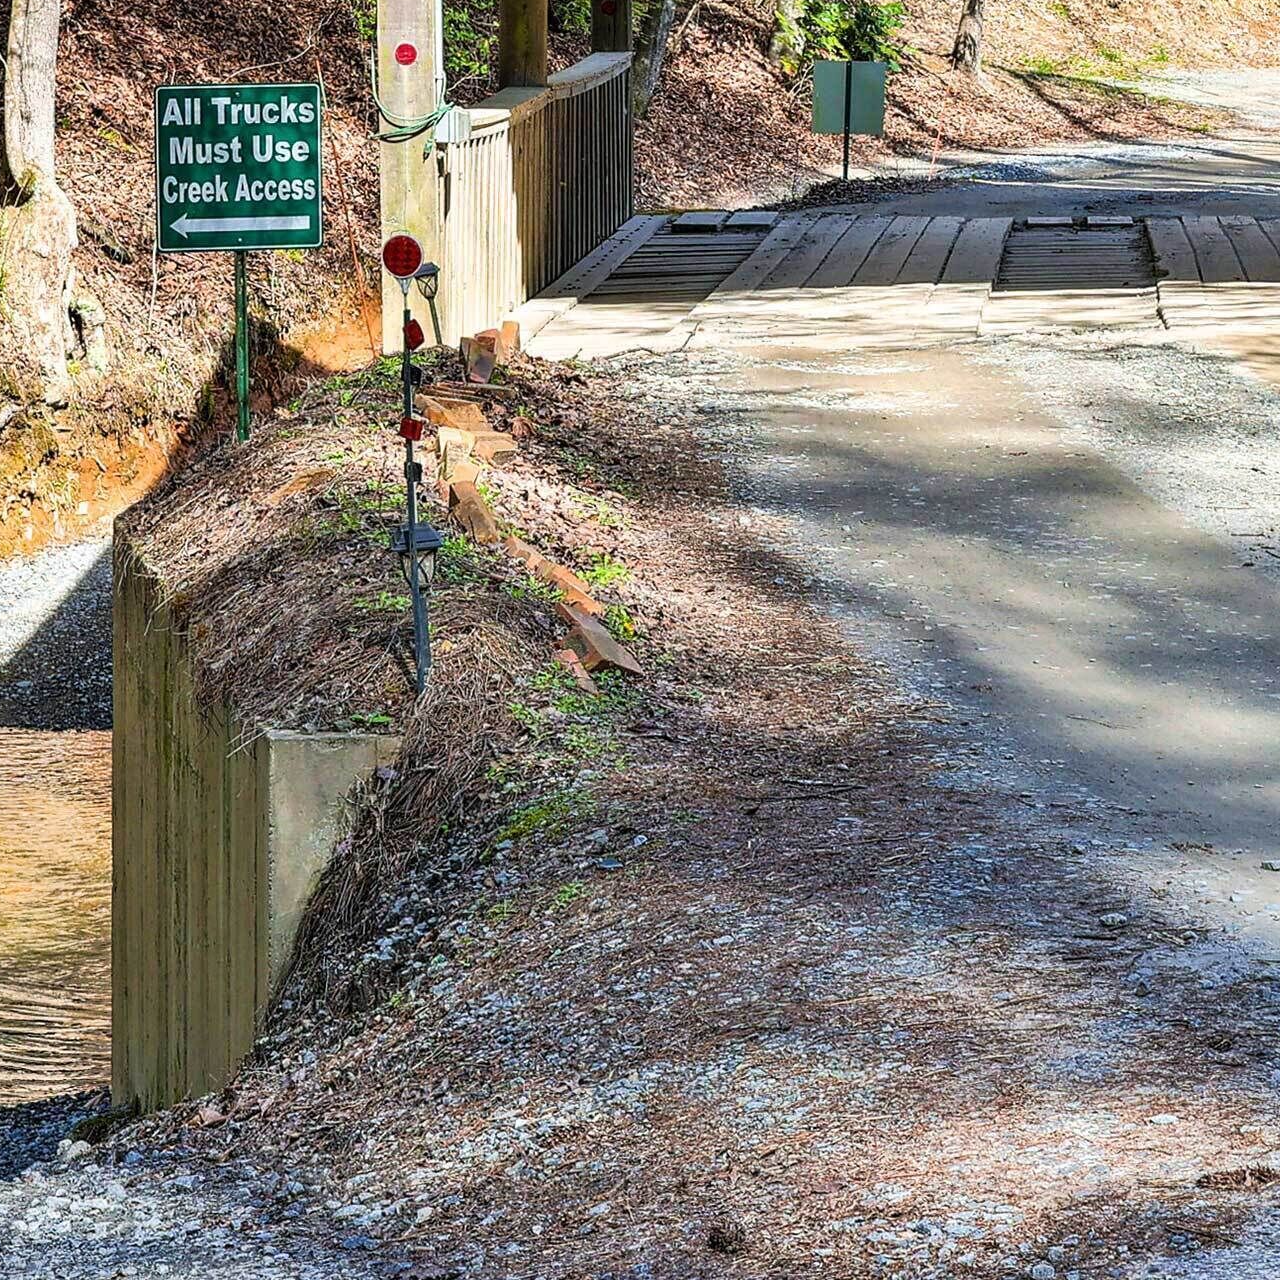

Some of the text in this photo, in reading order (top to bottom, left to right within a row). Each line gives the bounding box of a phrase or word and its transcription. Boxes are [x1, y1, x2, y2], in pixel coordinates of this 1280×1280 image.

[161, 95, 315, 126] All Trucks
[169, 134, 310, 165] Must Use
[162, 173, 317, 204] Creek Access
